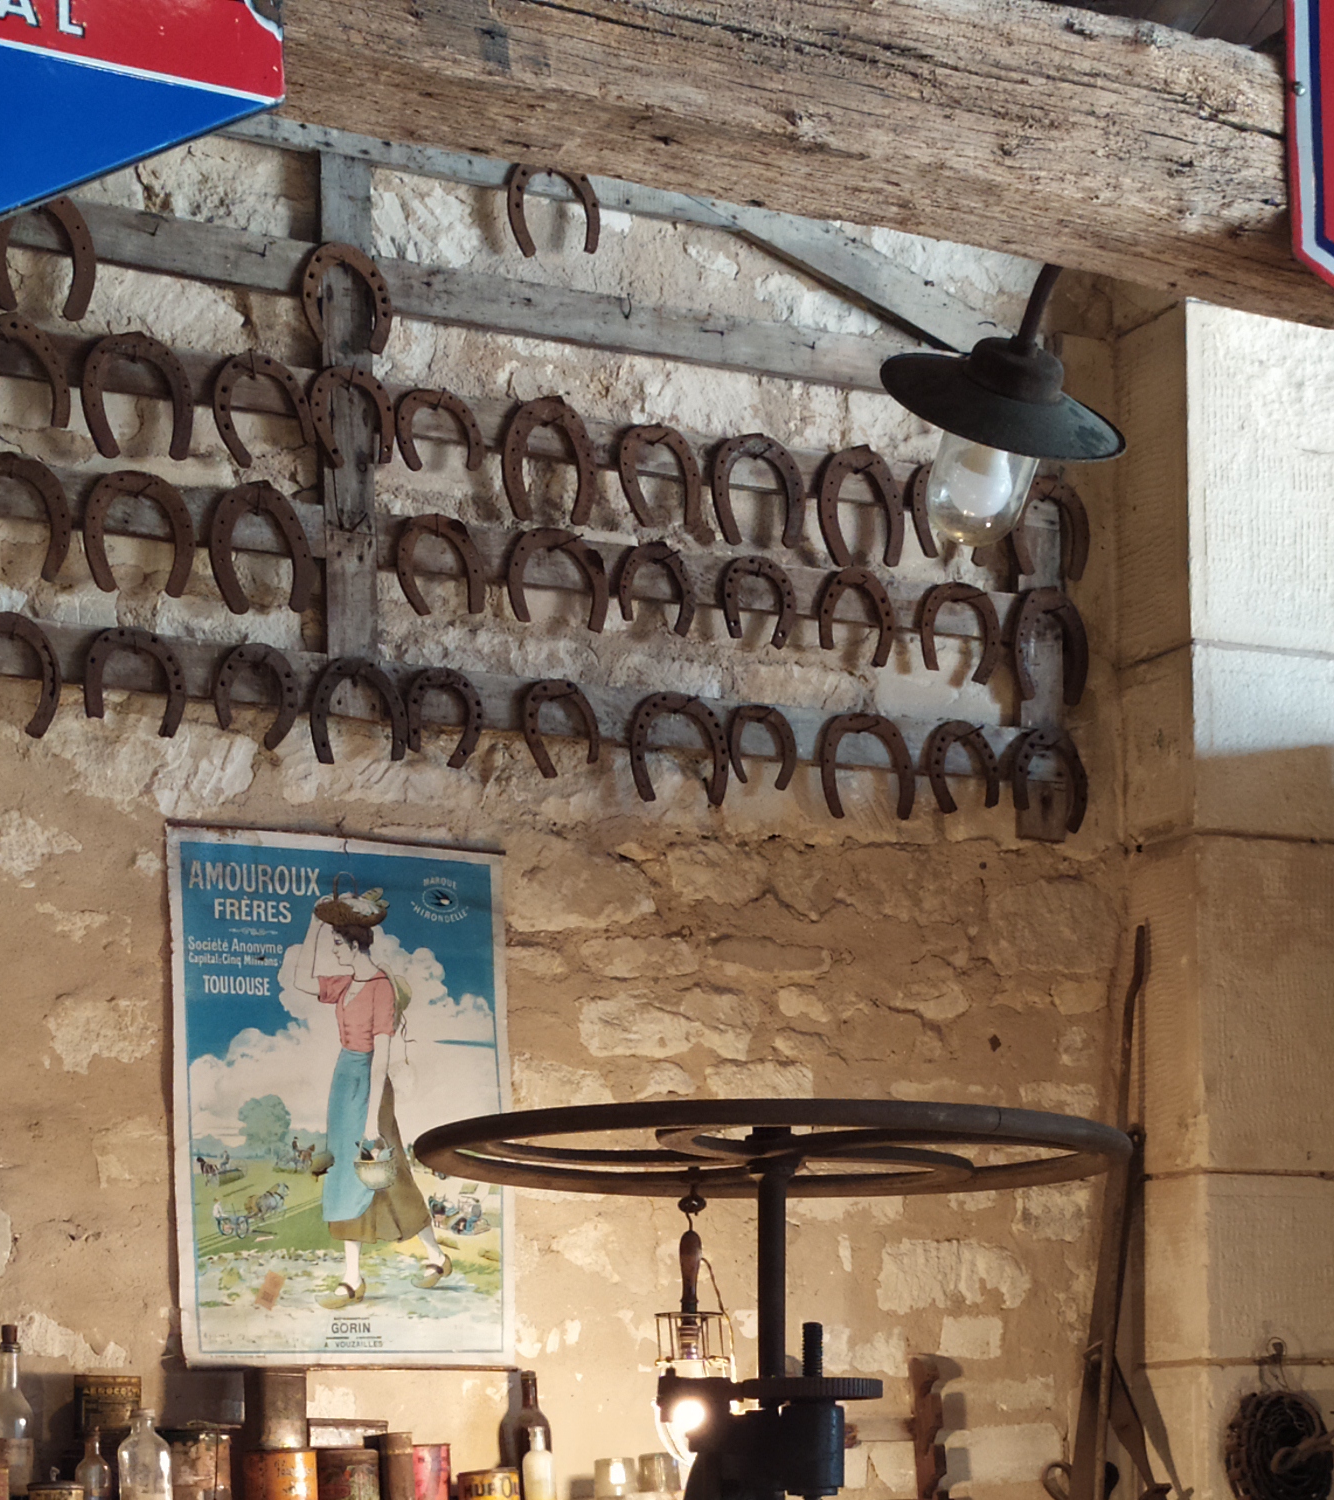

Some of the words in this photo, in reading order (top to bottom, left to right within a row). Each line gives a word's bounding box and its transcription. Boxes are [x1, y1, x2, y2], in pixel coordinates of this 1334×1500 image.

[188, 860, 321, 898] AMOUROUX
[423, 877, 458, 890] MARQUE
[214, 896, 292, 924] FRÈRES
[188, 936, 229, 951] Société
[231, 938, 284, 957] Anonyme
[202, 974, 271, 996] TOULOUSE
[331, 1322, 371, 1334] GORIN
